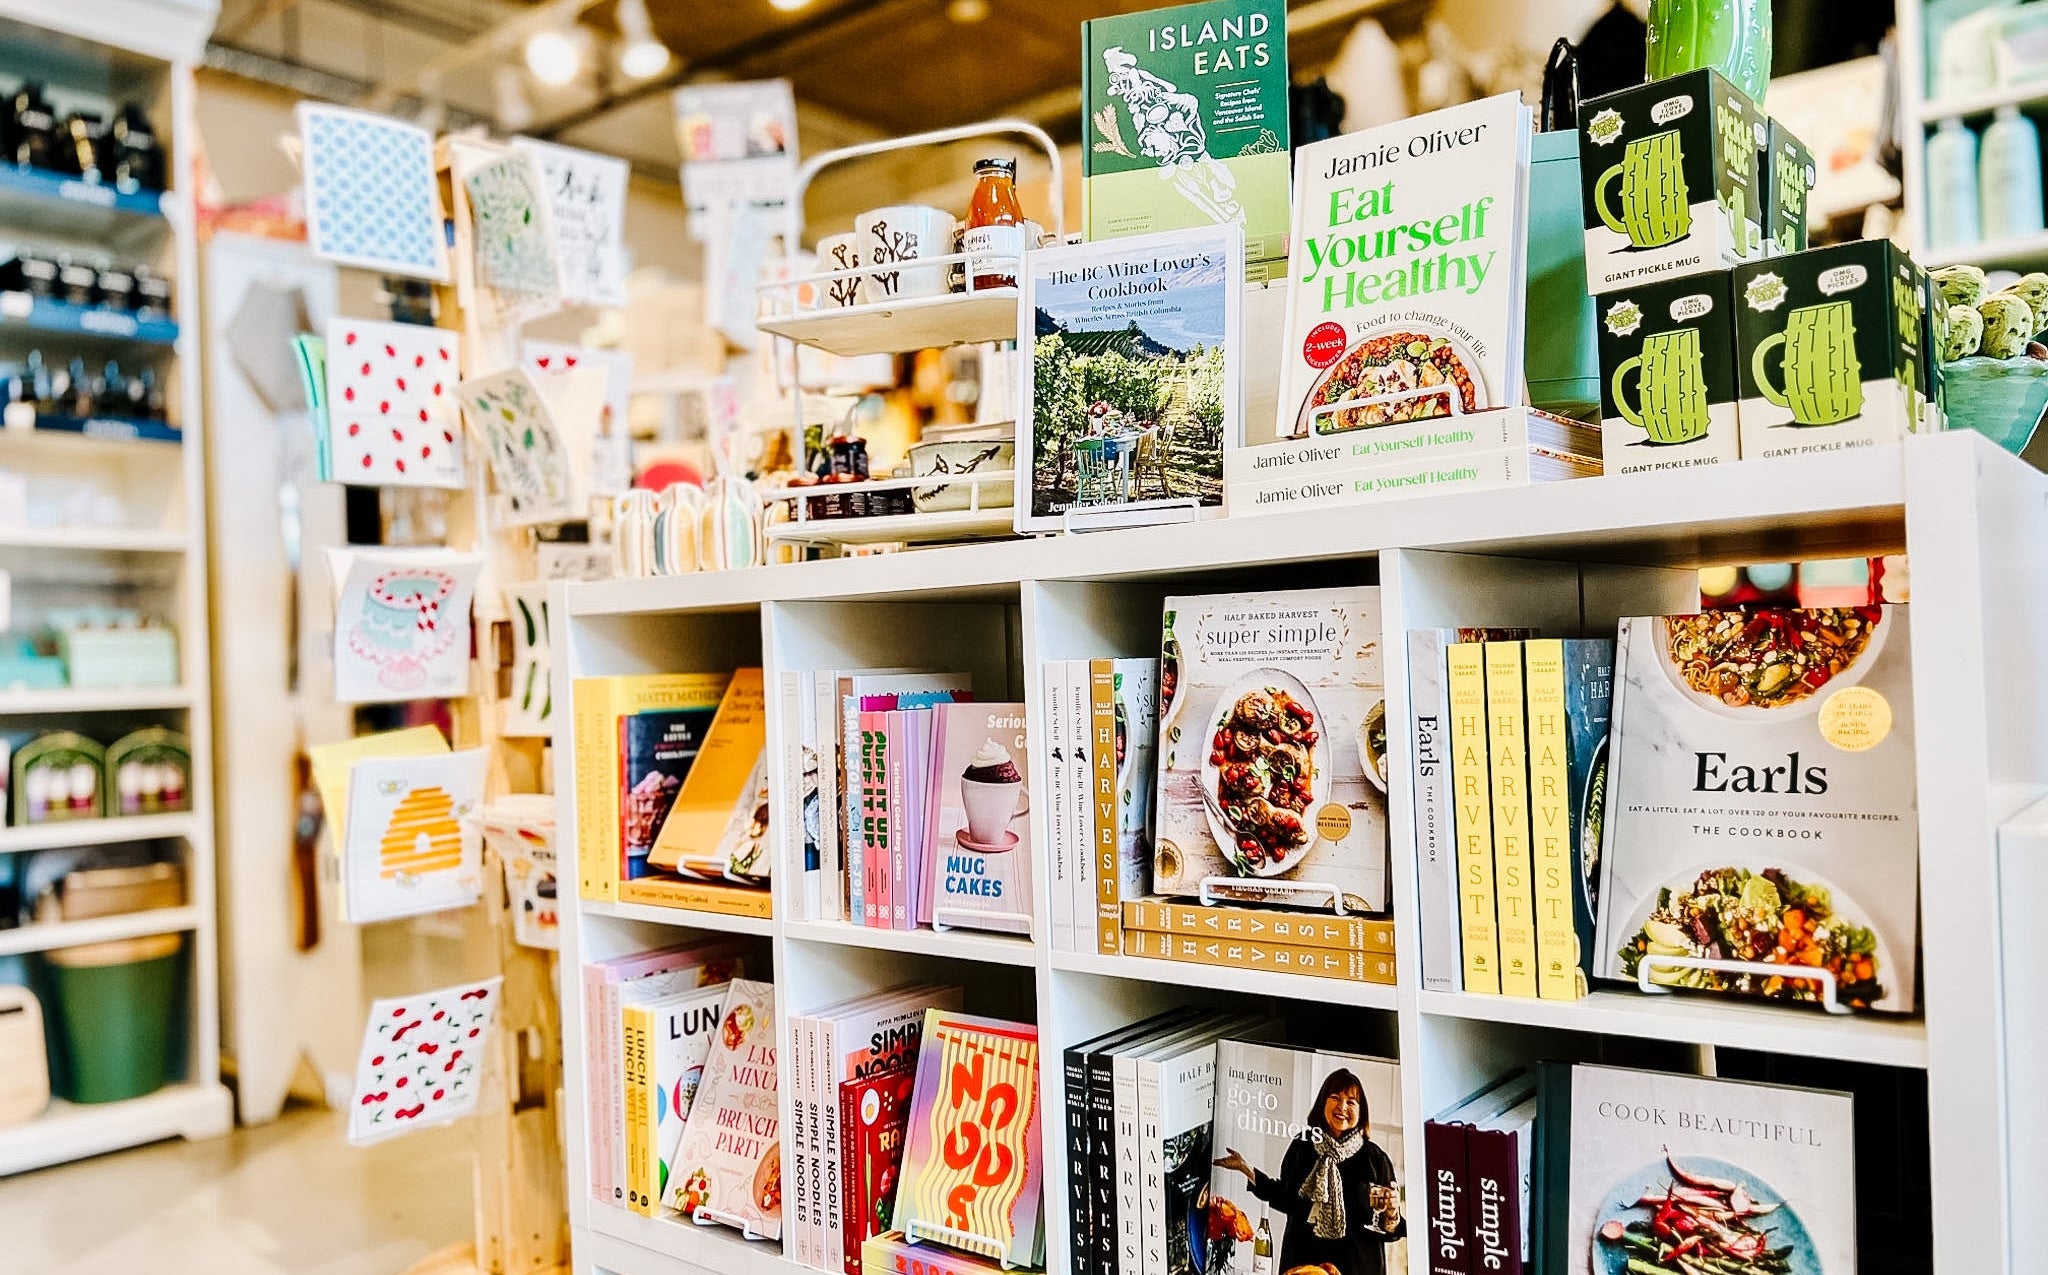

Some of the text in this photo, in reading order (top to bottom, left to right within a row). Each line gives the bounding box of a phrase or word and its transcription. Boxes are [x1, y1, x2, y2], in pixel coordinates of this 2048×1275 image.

[1149, 13, 1269, 52] ISLAND
[1194, 43, 1270, 75] EATS
[1658, 107, 1687, 120] PICKLES
[1663, 97, 1681, 109] OMG
[1664, 102, 1684, 114] LOVE
[1324, 123, 1487, 180] Jamie Oliver
[1328, 179, 1396, 228] Eat
[1049, 253, 1211, 286] The BC Wine Lover's
[1321, 251, 1497, 313] Healthy
[1604, 255, 1701, 284] GIANT PICKLE MUG
[1827, 278, 1860, 289] PICKLES
[1832, 268, 1852, 277] OMG
[1834, 273, 1855, 283] LOVE
[1088, 278, 1168, 300] Cookbook
[1682, 297, 1700, 306] OMG
[1677, 306, 1707, 317] PICKLES
[1684, 302, 1703, 311] LOVE
[1305, 336, 1345, 352] 2-week
[1310, 323, 1341, 339] INCLUDES
[1356, 310, 1489, 360] Food to change your life
[1253, 428, 1476, 470] Jamie Oliver Eat Yourself Healthy
[1763, 437, 1874, 459] GIANT PICKLE MUG
[1621, 455, 1719, 475] GIANT PICKLE MUG
[1255, 465, 1479, 505] Jamie Oliver Eat Yourself Healthy
[1224, 610, 1319, 622] HALF BAKED HARVEST
[1206, 622, 1337, 649] super simple
[987, 713, 1026, 728] Serio
[1417, 715, 1440, 777] Earls
[893, 760, 902, 805] Seriously
[1692, 751, 1828, 795] Earls
[861, 730, 875, 849] PUFF IT UP
[874, 730, 888, 850] PUFF IT UP
[893, 806, 903, 831] Good
[1098, 727, 1115, 895] HARVEST
[1461, 715, 1484, 915] HARVEST
[1498, 716, 1522, 917] HARVEST
[1539, 714, 1562, 919] HARVEST
[1628, 805, 1642, 813] EAT
[1809, 812, 1858, 820] FAVOURITE
[1427, 807, 1436, 863] COOKBOOK
[1693, 825, 1823, 840] THE COOKBOOK
[895, 853, 904, 882] Cakes
[946, 856, 985, 875] MUG
[945, 877, 1003, 898] CAKES
[1182, 912, 1340, 940] HARVEST
[1182, 940, 1340, 970] HARVEST
[670, 1004, 720, 1040] LUN
[747, 1045, 776, 1066] LAS
[625, 1027, 637, 1124] LUNCH WELL
[636, 1031, 648, 1127] LUNCH WELL
[1228, 1066, 1283, 1086] ina garten
[1226, 1083, 1278, 1110] go-to
[716, 1108, 778, 1138] BRUNCH
[1237, 1109, 1324, 1144] dinners
[1598, 1101, 1822, 1147] COOK BEAUTIFUL
[715, 1132, 765, 1160] PARTY
[795, 1098, 806, 1223] SIMPLE NOODLES
[810, 1102, 821, 1226] SIMPLE NOODLES
[826, 1105, 838, 1230] SIMPLE NOODLES
[1072, 1113, 1085, 1271] HARVEST
[1146, 1123, 1158, 1275] HARVES
[1432, 1169, 1464, 1260] simple
[1475, 1177, 1509, 1270] simple
